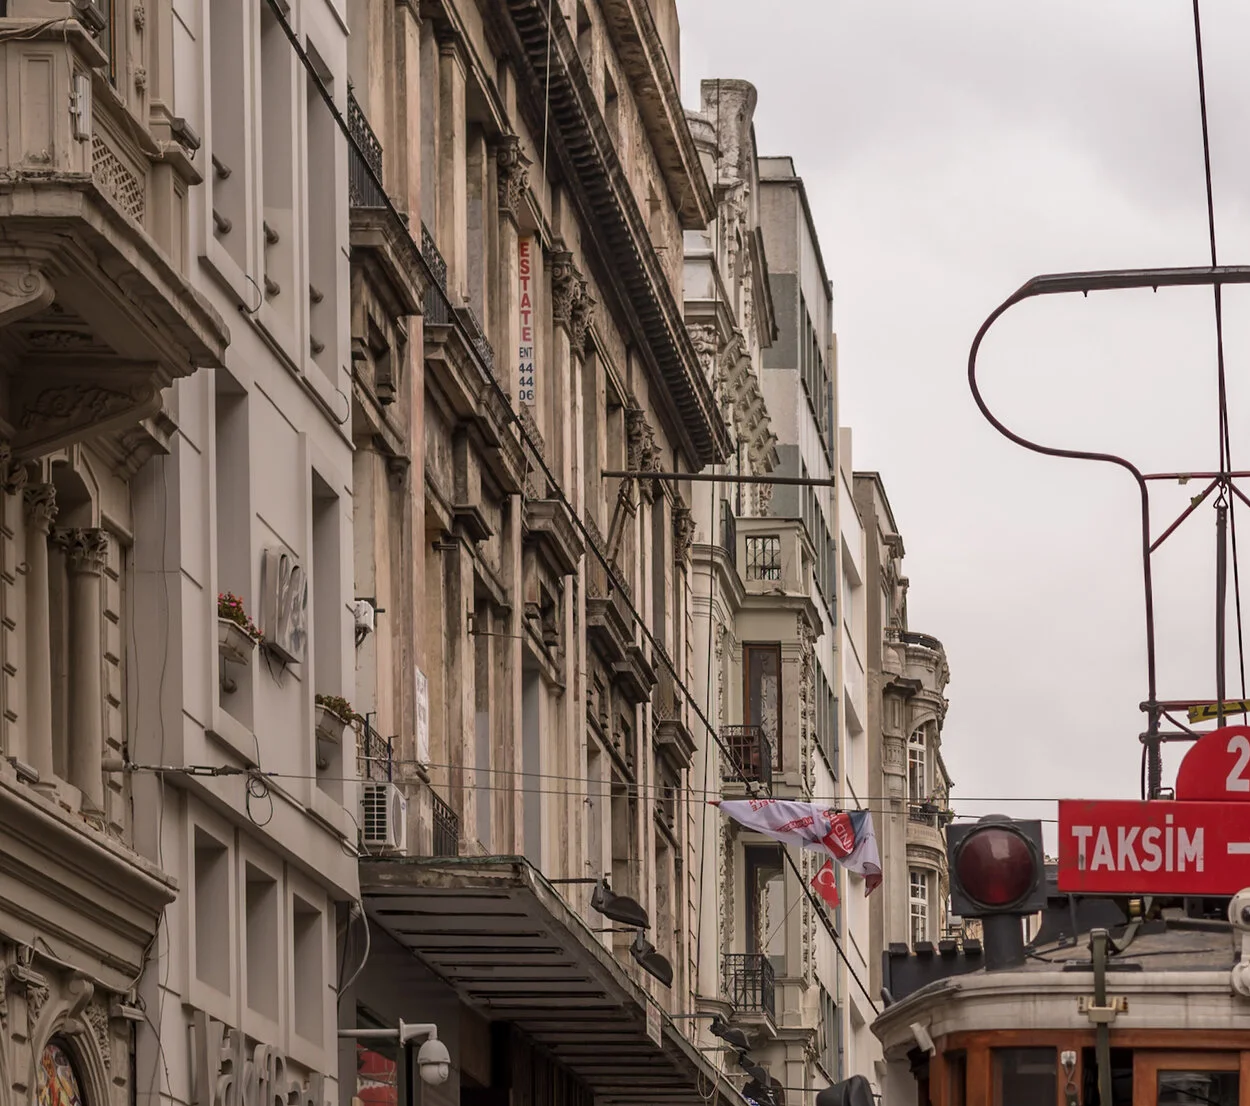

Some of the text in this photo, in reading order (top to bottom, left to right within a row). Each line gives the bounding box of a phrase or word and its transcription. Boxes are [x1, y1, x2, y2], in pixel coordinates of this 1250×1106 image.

[520, 242, 532, 342] ESTATE
[1225, 734, 1250, 792] 2
[1072, 814, 1205, 872] TAKSİM
